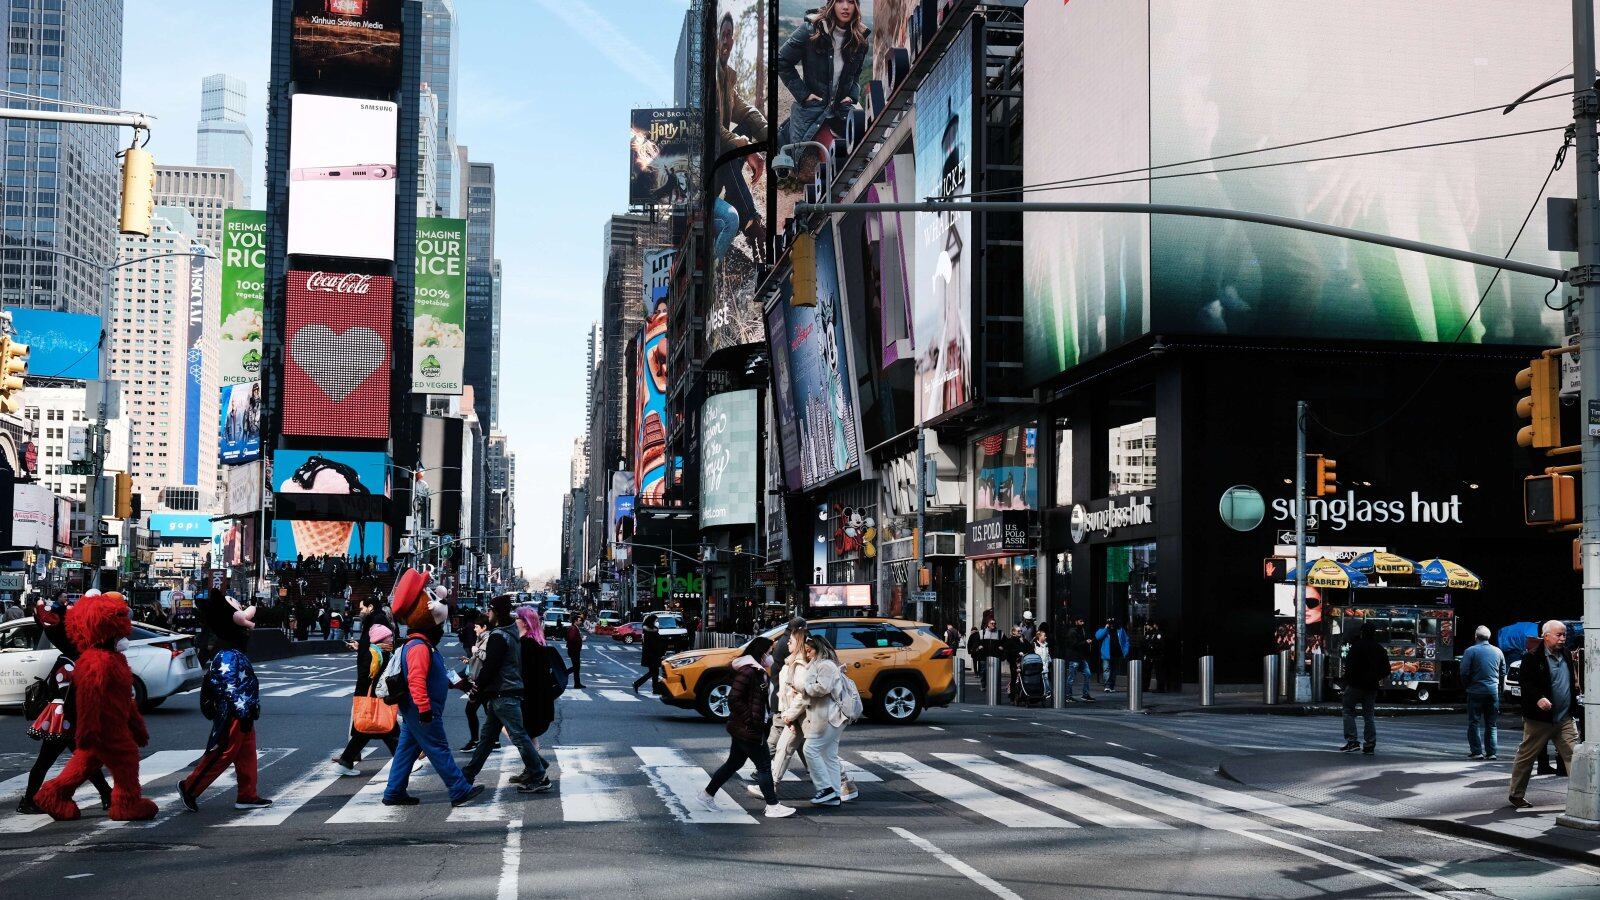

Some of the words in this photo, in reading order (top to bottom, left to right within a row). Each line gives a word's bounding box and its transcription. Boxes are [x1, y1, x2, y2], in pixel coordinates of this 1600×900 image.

[311, 15, 336, 25] Xinhua
[337, 18, 361, 28] Screen
[362, 20, 384, 30] Media
[360, 104, 393, 112] SAMSUNG
[650, 122, 678, 141] Harry
[416, 240, 460, 255] OUR
[306, 271, 373, 294] Coca-Cola
[415, 299, 450, 307] egetables
[1272, 490, 1405, 531] sunglass
[1411, 491, 1463, 523] hut
[983, 521, 1001, 541] POLO
[1005, 530, 1026, 538] POLO
[1005, 537, 1027, 545] ASSN.
[1376, 564, 1411, 572] SABRETT
[1309, 578, 1346, 586] SABRETT
[1450, 579, 1478, 588] SABRETT
